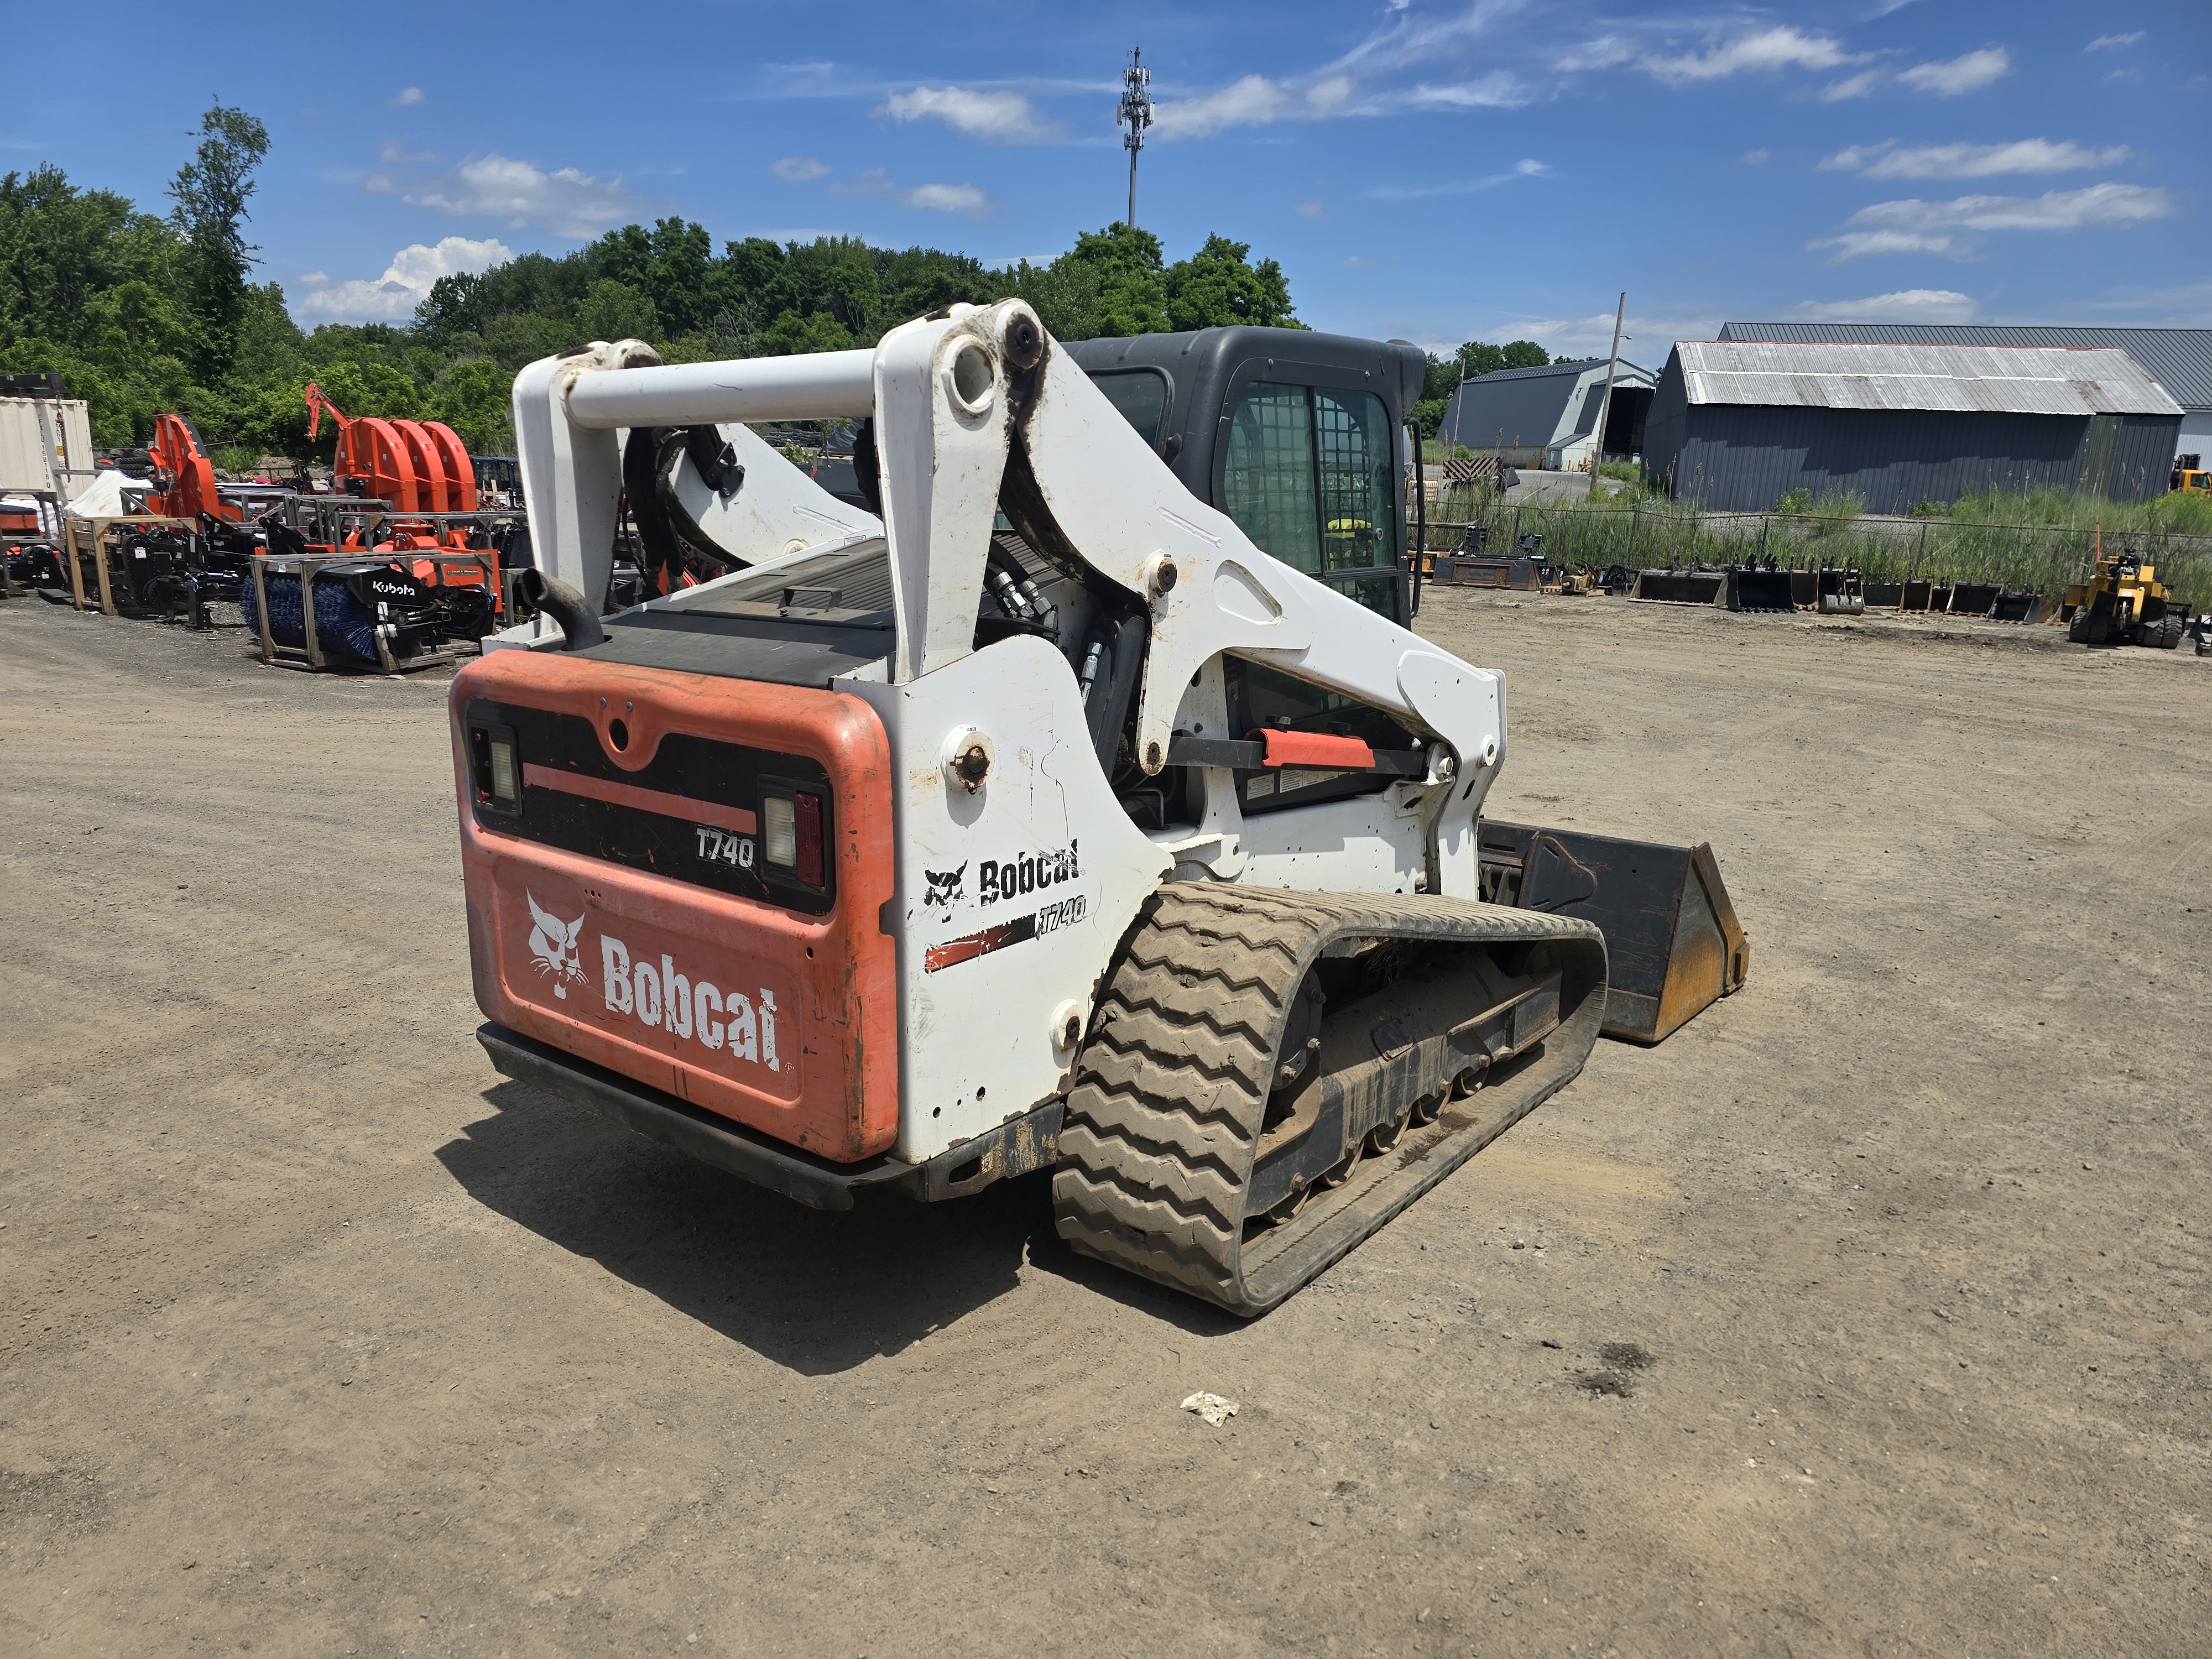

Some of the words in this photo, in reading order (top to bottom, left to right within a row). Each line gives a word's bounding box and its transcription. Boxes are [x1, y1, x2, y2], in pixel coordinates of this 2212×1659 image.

[373, 581, 415, 596] Kubota
[697, 828, 754, 868] T740
[979, 838, 1079, 907] Bobcat
[1040, 895, 1086, 935] T740
[601, 933, 780, 1072] Bobcat
